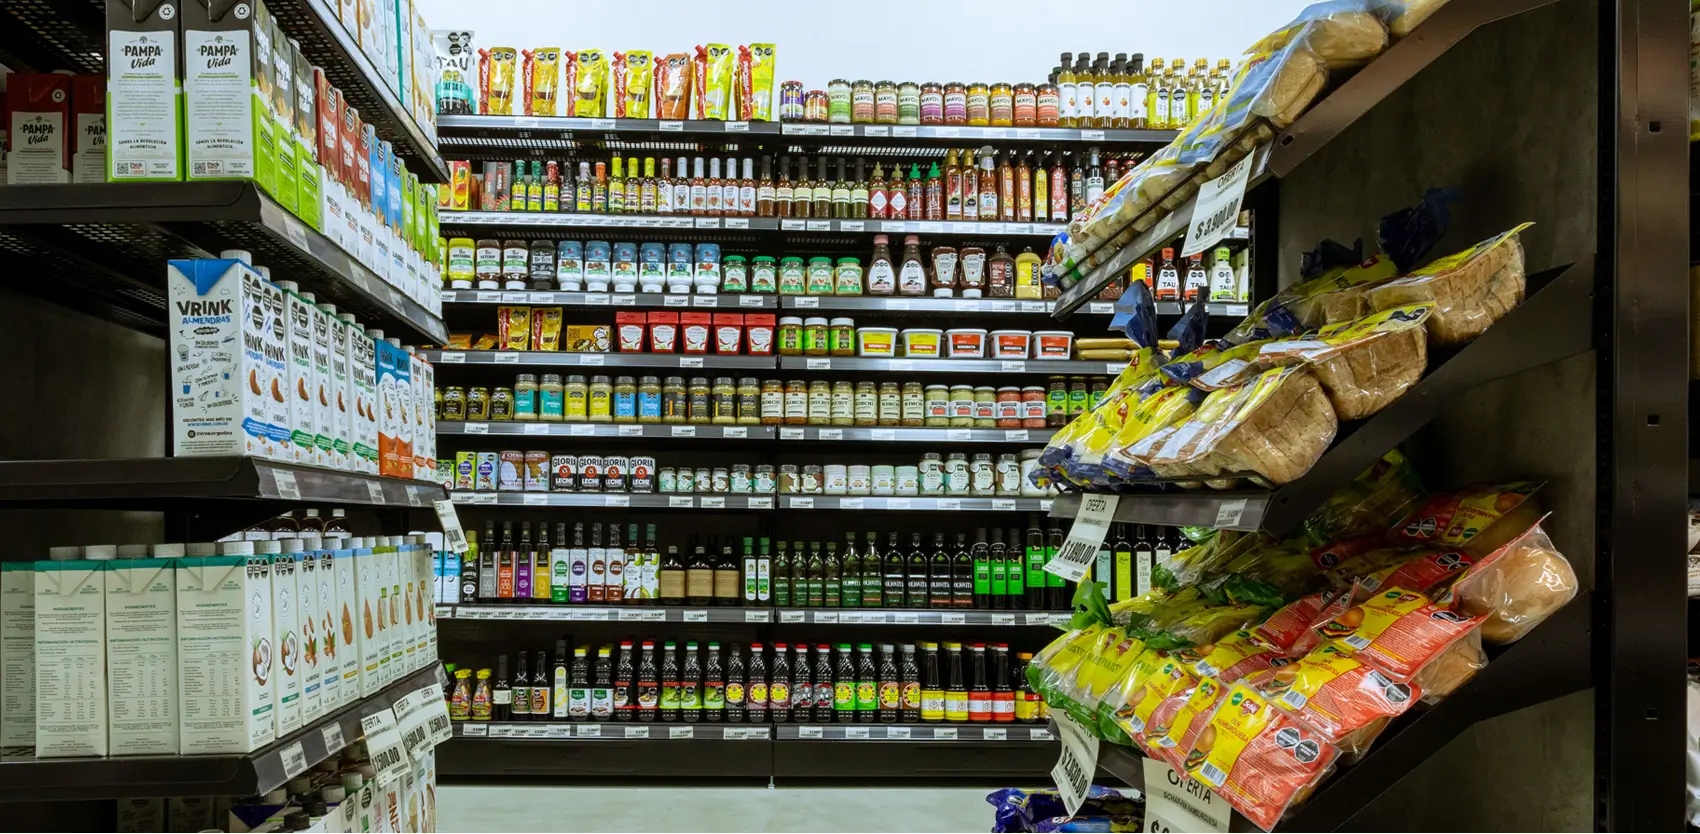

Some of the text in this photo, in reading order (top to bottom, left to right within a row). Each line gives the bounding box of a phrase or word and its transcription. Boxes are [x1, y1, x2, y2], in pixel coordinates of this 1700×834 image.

[125, 46, 161, 56] PAMPA
[200, 45, 236, 56] PAMPA
[131, 57, 156, 69] Vida
[207, 56, 231, 69] Vida
[23, 124, 53, 134] PAMPA
[28, 134, 48, 144] Vida
[1218, 162, 1244, 188] OFERTA
[176, 299, 232, 316] VRINK
[182, 315, 231, 325] ALMENDRAS
[264, 342, 285, 361] VRINK
[553, 458, 576, 467] GLORIA
[580, 458, 603, 468] GLORIA
[604, 458, 626, 468] GLORIA
[630, 458, 653, 469] GLORIA
[1086, 499, 1107, 513] OFERTA
[362, 717, 381, 731] OFERTA
[1216, 719, 1249, 743] HAMBURGUESA
[1187, 803, 1218, 829] HAMBURGUESA
